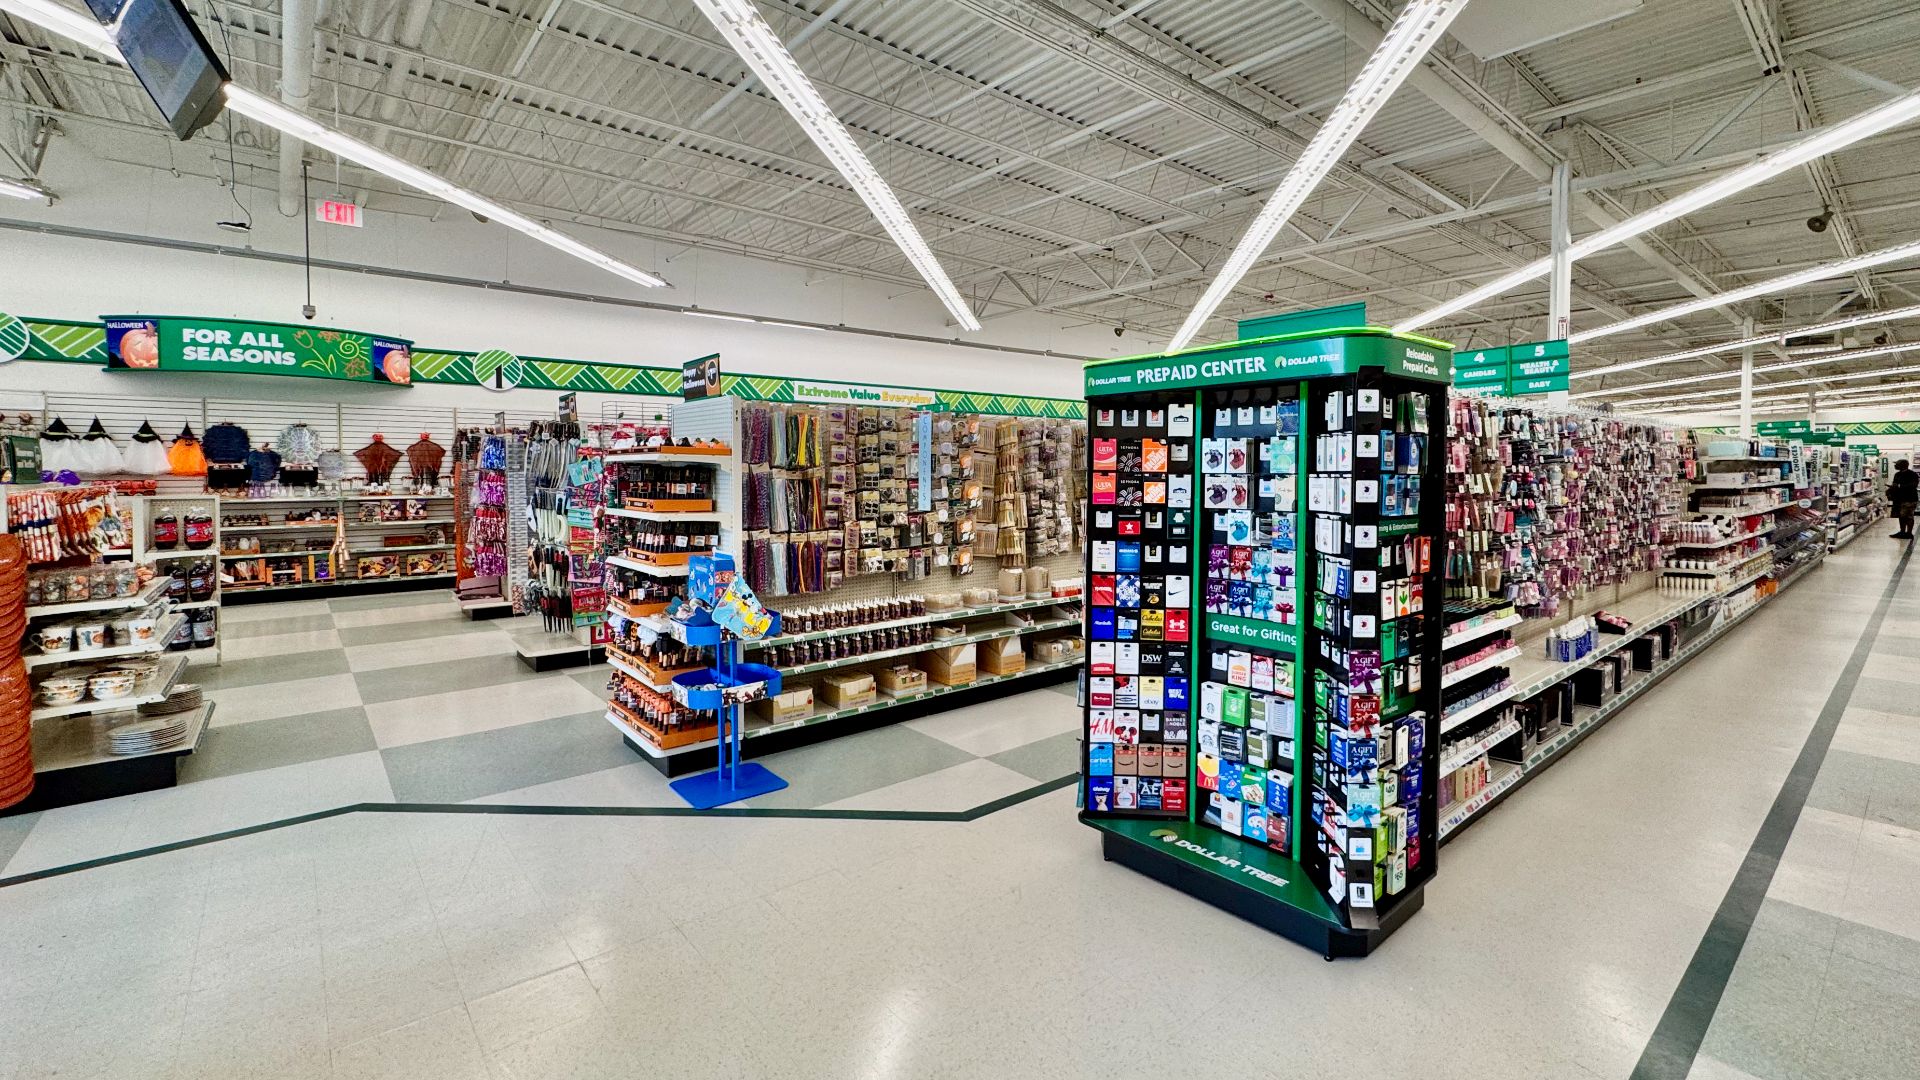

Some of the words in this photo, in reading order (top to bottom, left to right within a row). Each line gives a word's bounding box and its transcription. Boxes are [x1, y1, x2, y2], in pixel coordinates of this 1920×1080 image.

[324, 201, 356, 225] EXIT
[107, 321, 144, 329] HALLOWEEN
[183, 328, 232, 345] FOR
[239, 331, 284, 348] ALL
[373, 340, 402, 350] HALLOWEEN
[183, 346, 297, 366] SEASONS
[1406, 347, 1435, 363] Reloadable
[1534, 345, 1545, 357] 5
[1287, 355, 1318, 366] DOLLAR
[1319, 353, 1340, 362] TREE
[1473, 352, 1485, 363] 4
[1402, 360, 1424, 373] Prepaid
[1424, 363, 1439, 376] Cards
[1519, 360, 1550, 370] HEALTH
[1524, 366, 1556, 375] BEAUTY
[1136, 365, 1198, 385] PREPAID
[1201, 357, 1267, 377] CENTER
[1463, 369, 1497, 378] CANDLES
[1095, 377, 1117, 386] DOLLAR
[1117, 375, 1132, 384] TREE
[1528, 380, 1552, 389] BABY
[797, 385, 849, 398] Extreme
[849, 389, 881, 400] Value
[882, 391, 932, 405] Everyday
[1791, 445, 1800, 472] CHOICES
[1211, 621, 1239, 635] Great
[1242, 625, 1258, 637] for
[1260, 628, 1296, 646] Gifting
[1141, 654, 1162, 662] DSW
[1359, 657, 1376, 667] GIFT
[1360, 702, 1376, 712] GIFT
[1357, 747, 1374, 756] GIFT
[1175, 840, 1241, 868] DOLLAR
[1241, 864, 1290, 887] TREE
